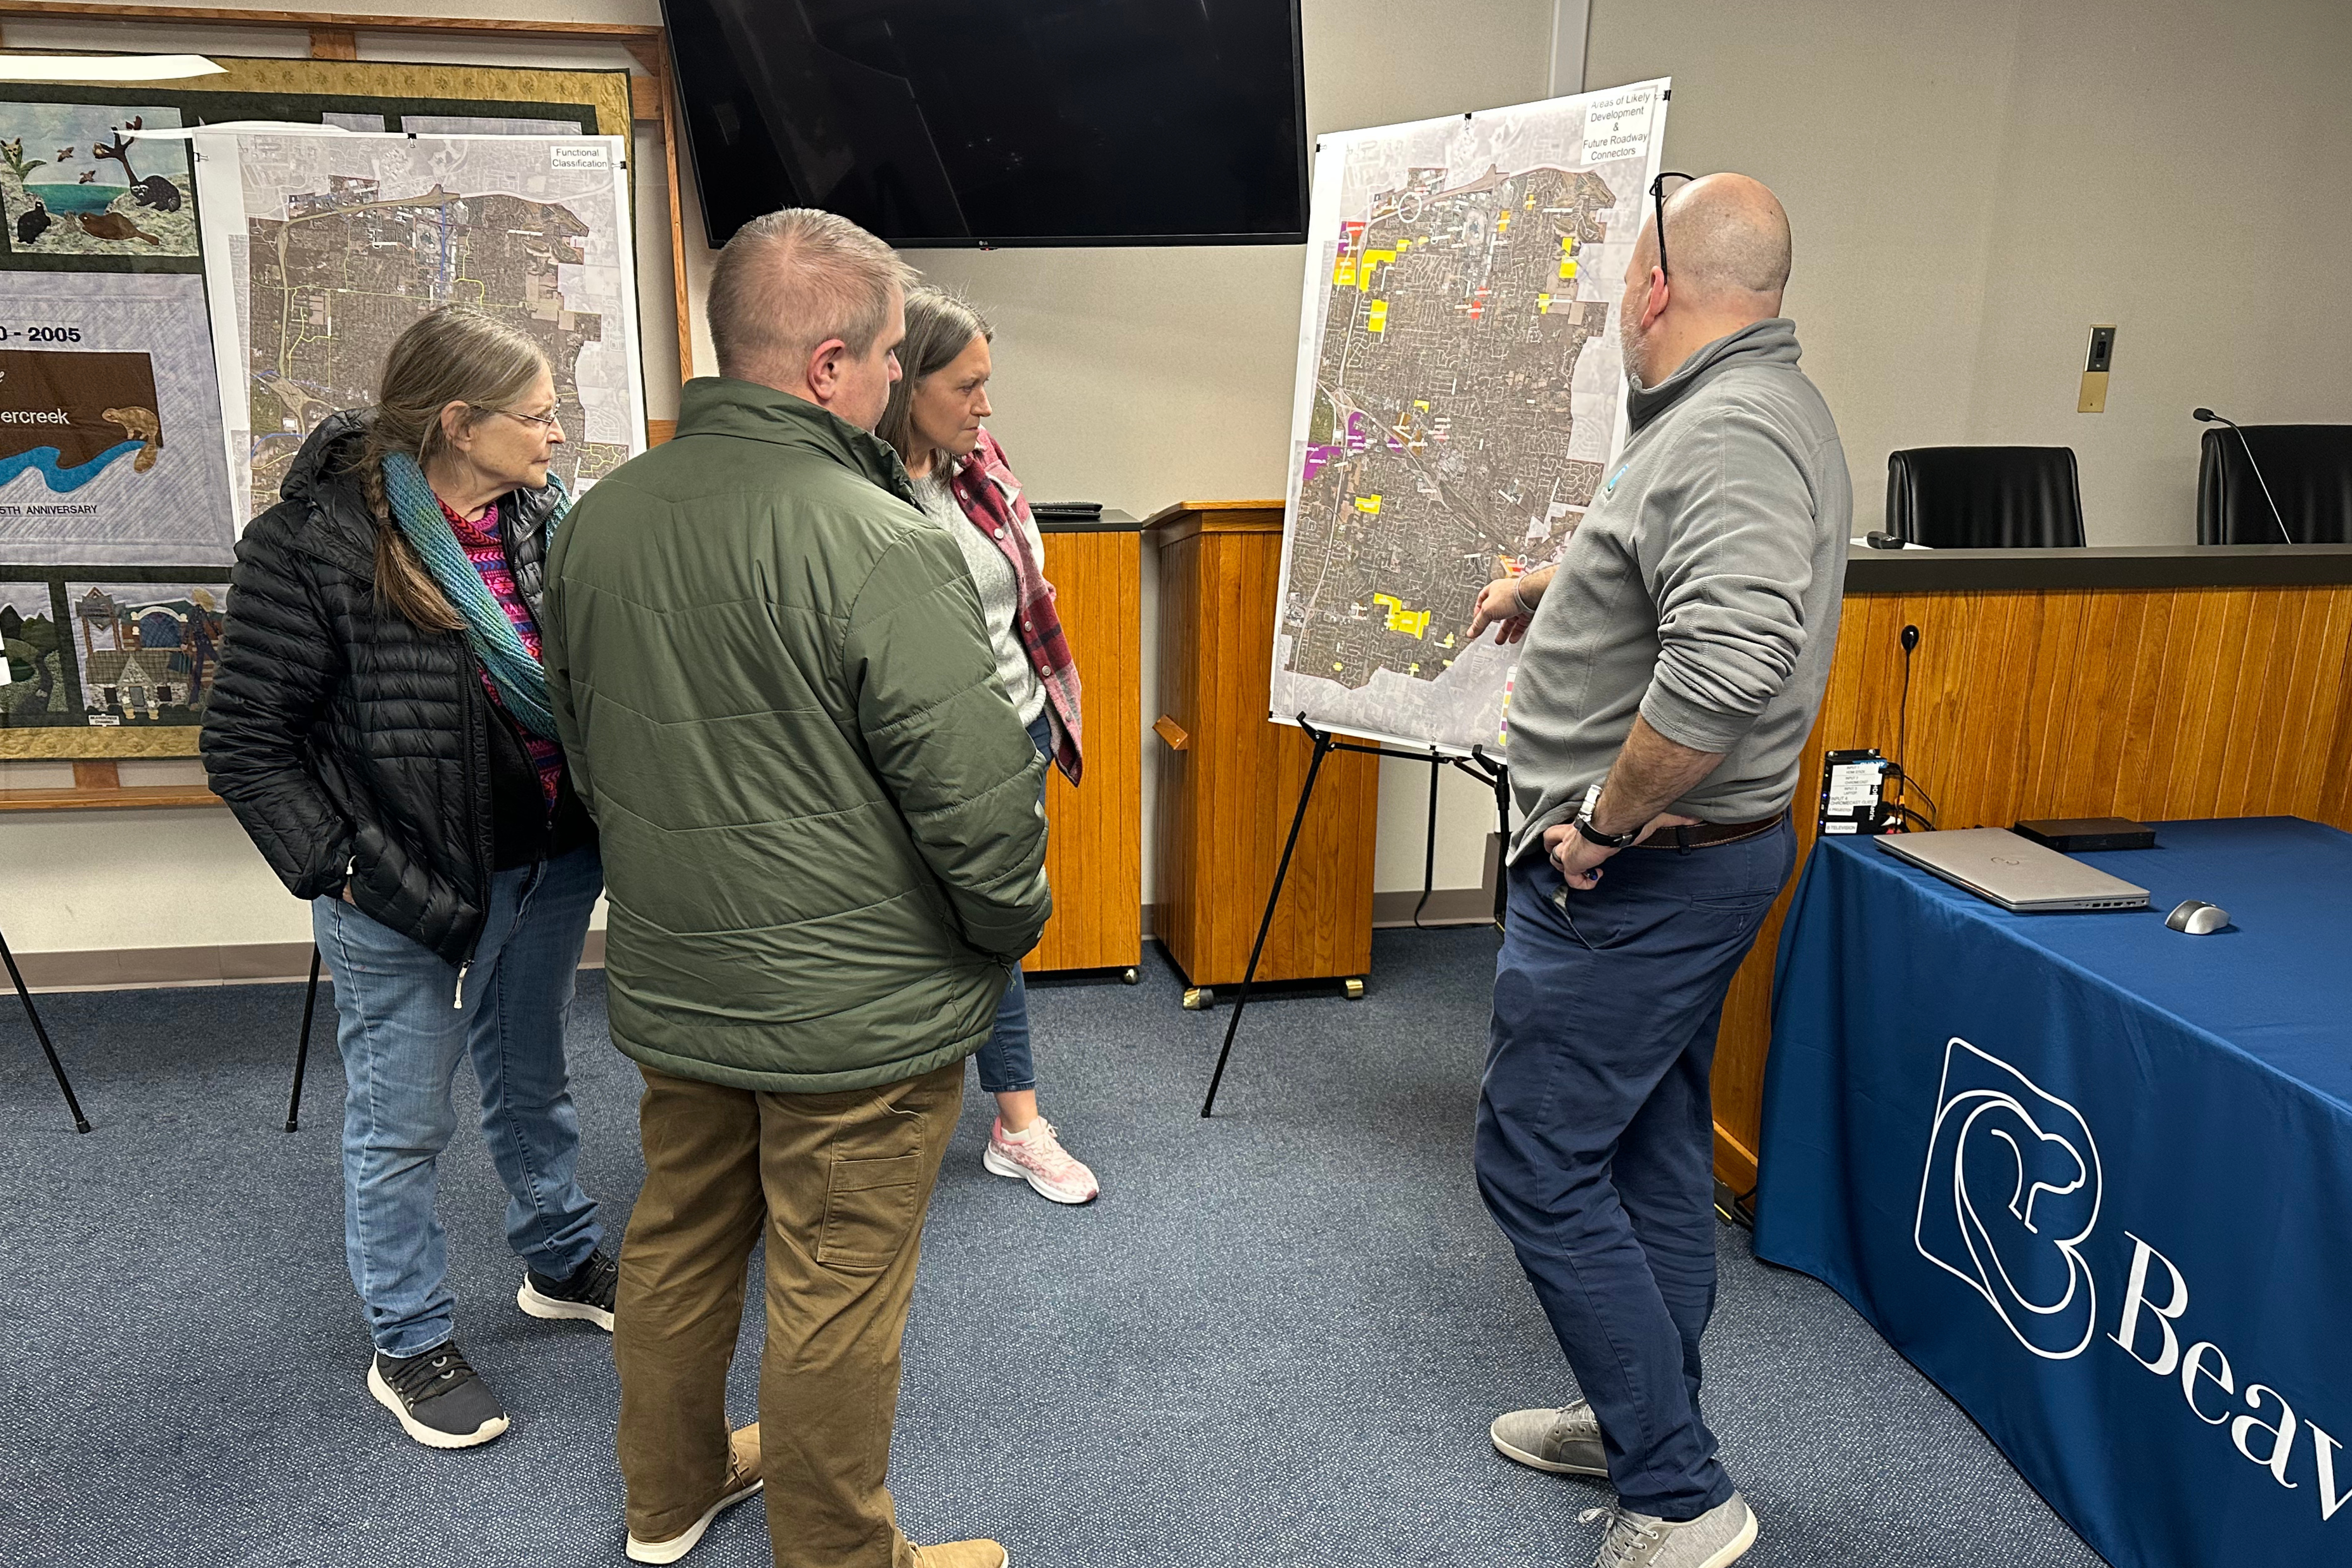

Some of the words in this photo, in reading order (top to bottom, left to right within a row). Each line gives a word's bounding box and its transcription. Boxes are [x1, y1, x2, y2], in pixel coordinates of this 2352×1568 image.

[1591, 99, 1614, 109] Areas
[1616, 95, 1624, 105] of
[1626, 92, 1651, 105] Likely
[1591, 106, 1644, 122] Development
[1613, 122, 1619, 132] &
[1583, 139, 1608, 150] Future
[1610, 133, 1649, 145] Roadway
[1591, 147, 1636, 161] Connectors
[552, 159, 607, 168] Classification
[28, 327, 81, 342] 2005
[1, 408, 71, 425] ercreek
[27, 505, 98, 514] ANNIVERSARY
